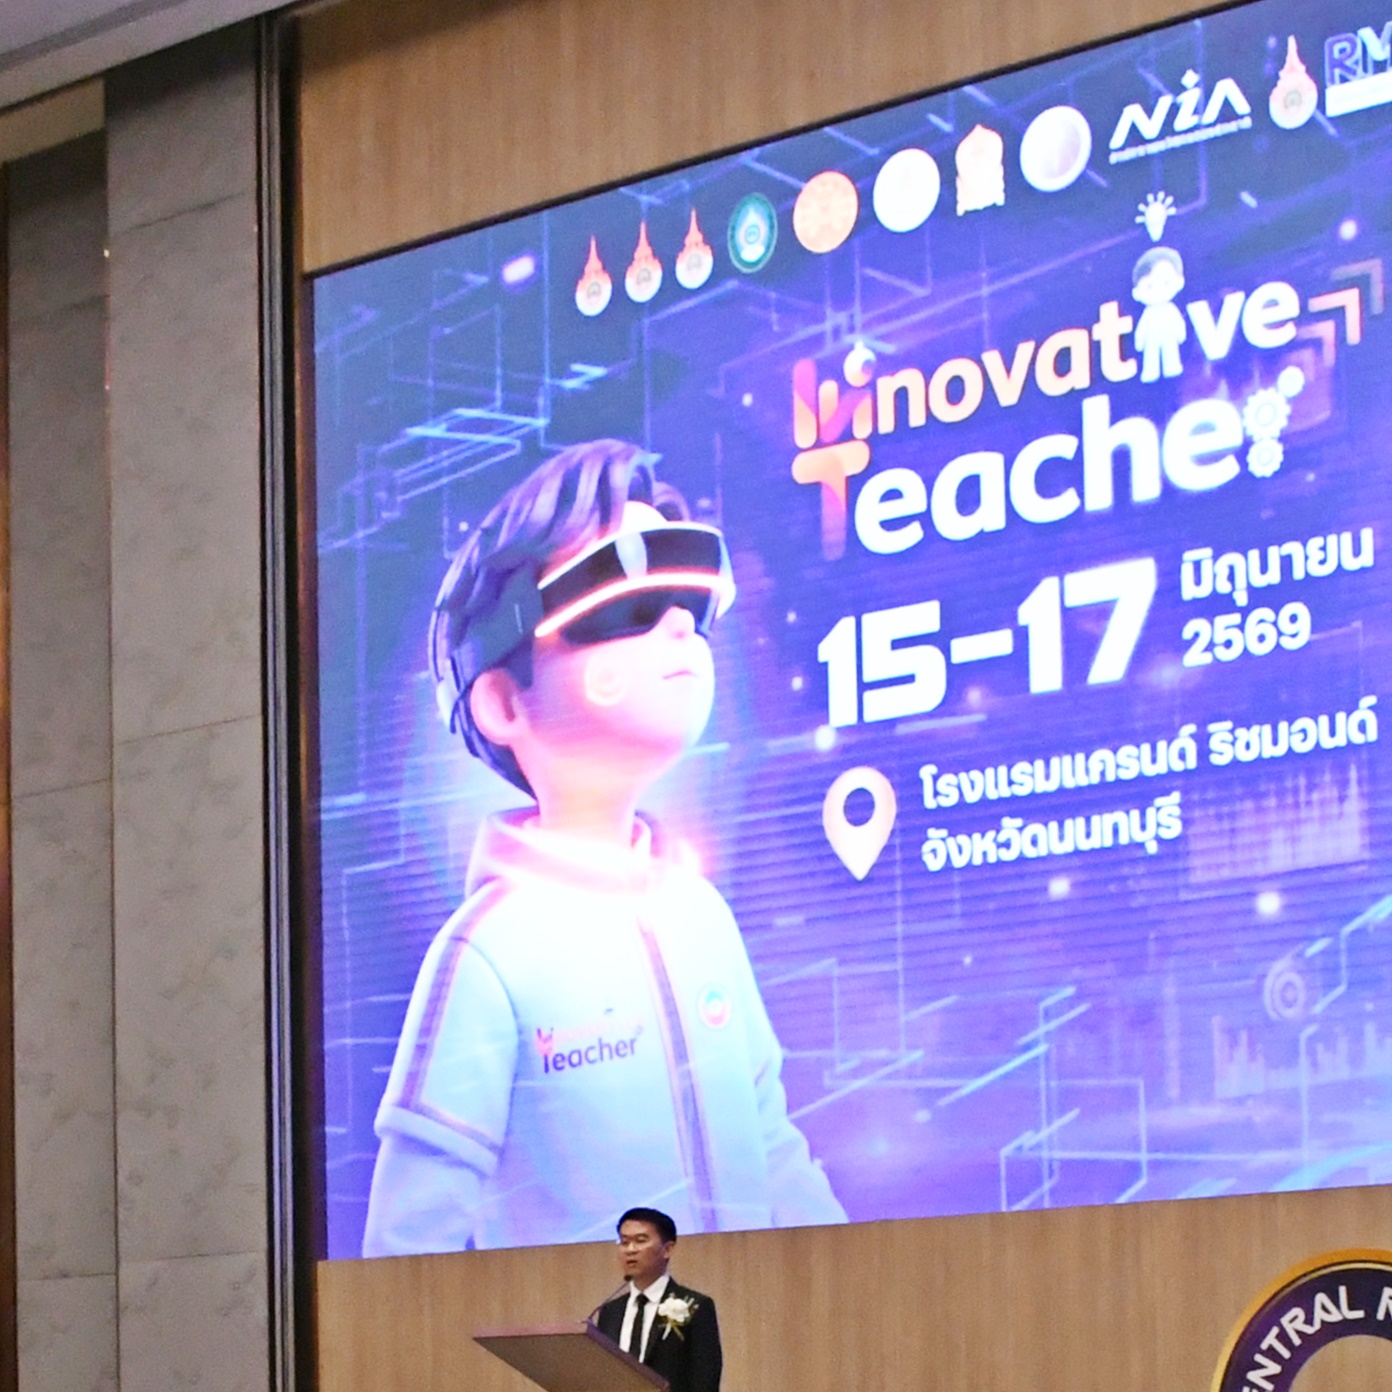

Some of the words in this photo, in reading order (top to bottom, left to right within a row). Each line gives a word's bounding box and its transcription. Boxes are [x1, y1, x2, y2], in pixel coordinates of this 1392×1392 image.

[1180, 527, 1376, 607] มิถุนายน
[817, 556, 1158, 728] 15-17
[1181, 601, 1311, 669] 2569
[920, 726, 1197, 810] โรงแรมแกรนด์
[1208, 695, 1378, 767] ริชมอนด์
[921, 793, 1182, 872] จังหวัดนนทบุรี
